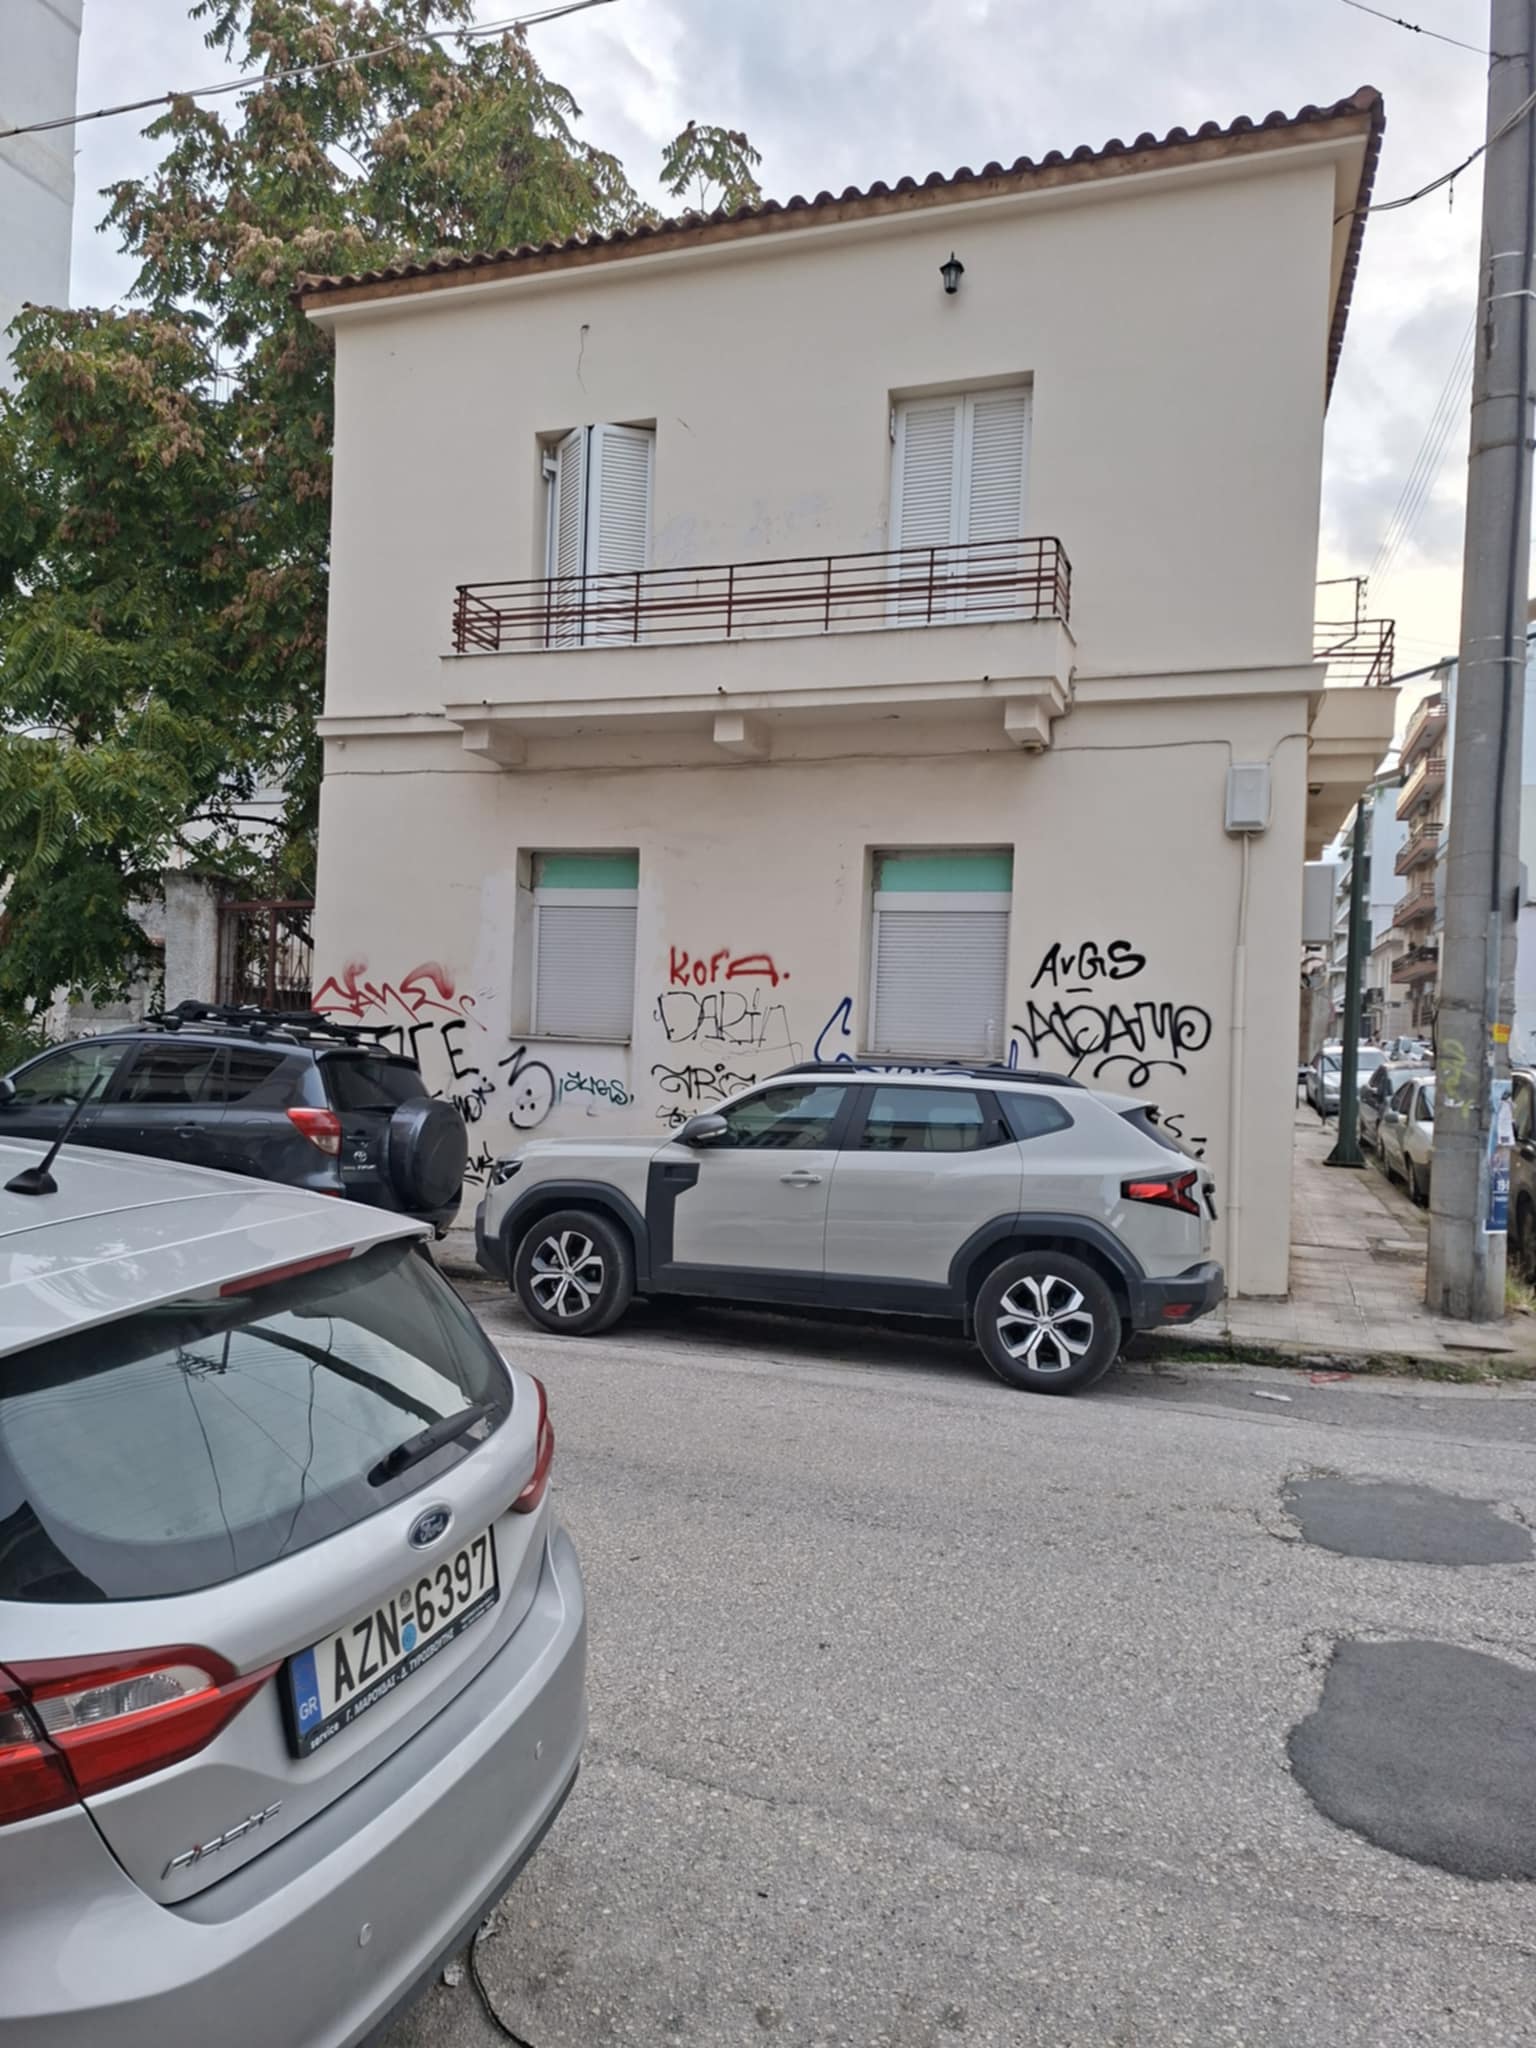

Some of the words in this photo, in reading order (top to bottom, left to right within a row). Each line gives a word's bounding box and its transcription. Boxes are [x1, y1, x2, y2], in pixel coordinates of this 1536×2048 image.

[418, 1513, 447, 1542] Ford
[333, 1533, 487, 1704] AZN-6397
[299, 1695, 319, 1720] GR
[309, 1720, 341, 1750] service
